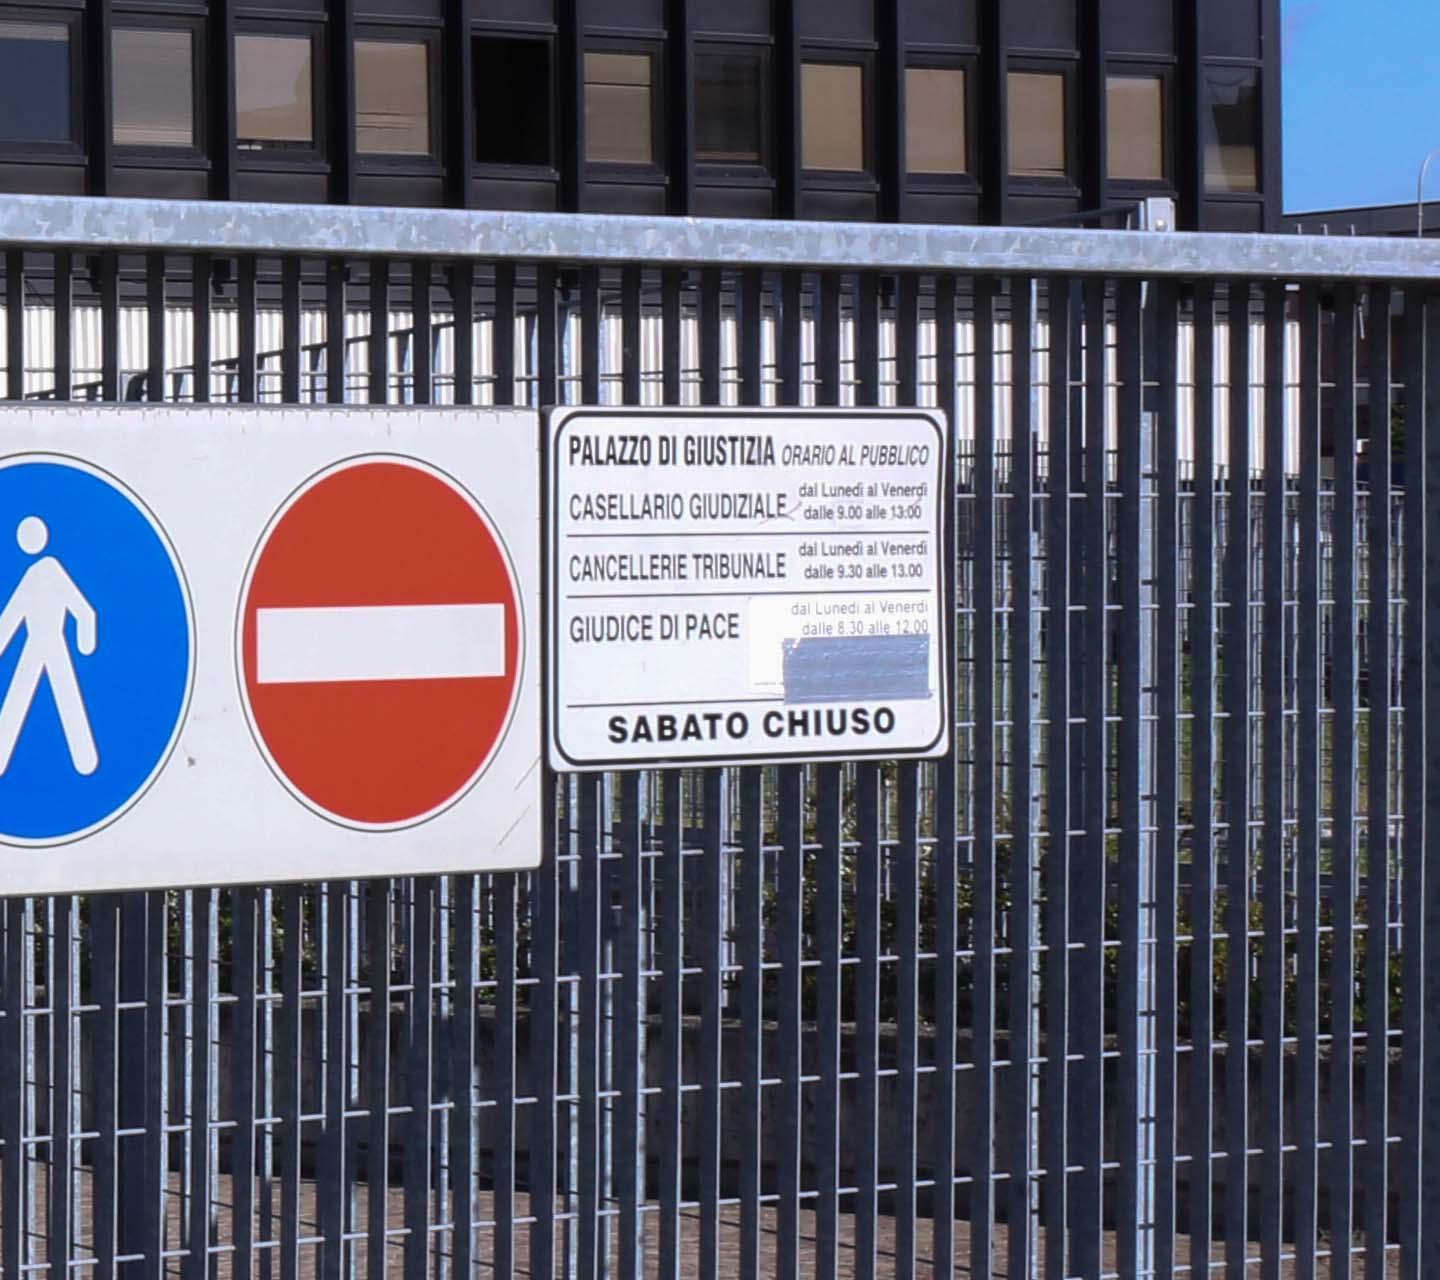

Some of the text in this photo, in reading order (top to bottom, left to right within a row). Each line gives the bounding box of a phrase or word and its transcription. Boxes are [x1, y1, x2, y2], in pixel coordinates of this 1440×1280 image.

[569, 435, 776, 466] PALAZZO DI GIUSTIZIA
[781, 443, 929, 466] ORARIO AL PUBBLICO
[798, 482, 818, 498] dal
[867, 481, 878, 497] al
[569, 492, 787, 521] CASELLARIO GIUDIZIALE
[803, 505, 834, 520] dalle
[837, 505, 863, 520] 9.00
[865, 505, 888, 520] alle
[798, 541, 818, 556] dal
[866, 540, 878, 556] al
[569, 552, 786, 582] CANCELLERIE TRIBUNALE
[804, 563, 923, 579] dalle 9.30 alle 13.00
[791, 601, 811, 616] dal
[864, 600, 875, 615] al
[569, 612, 740, 643] GIUDICE DI PACE
[801, 619, 929, 636] dalle 8.30 alle 12.00
[607, 706, 897, 744] SABATO CHIUSO
